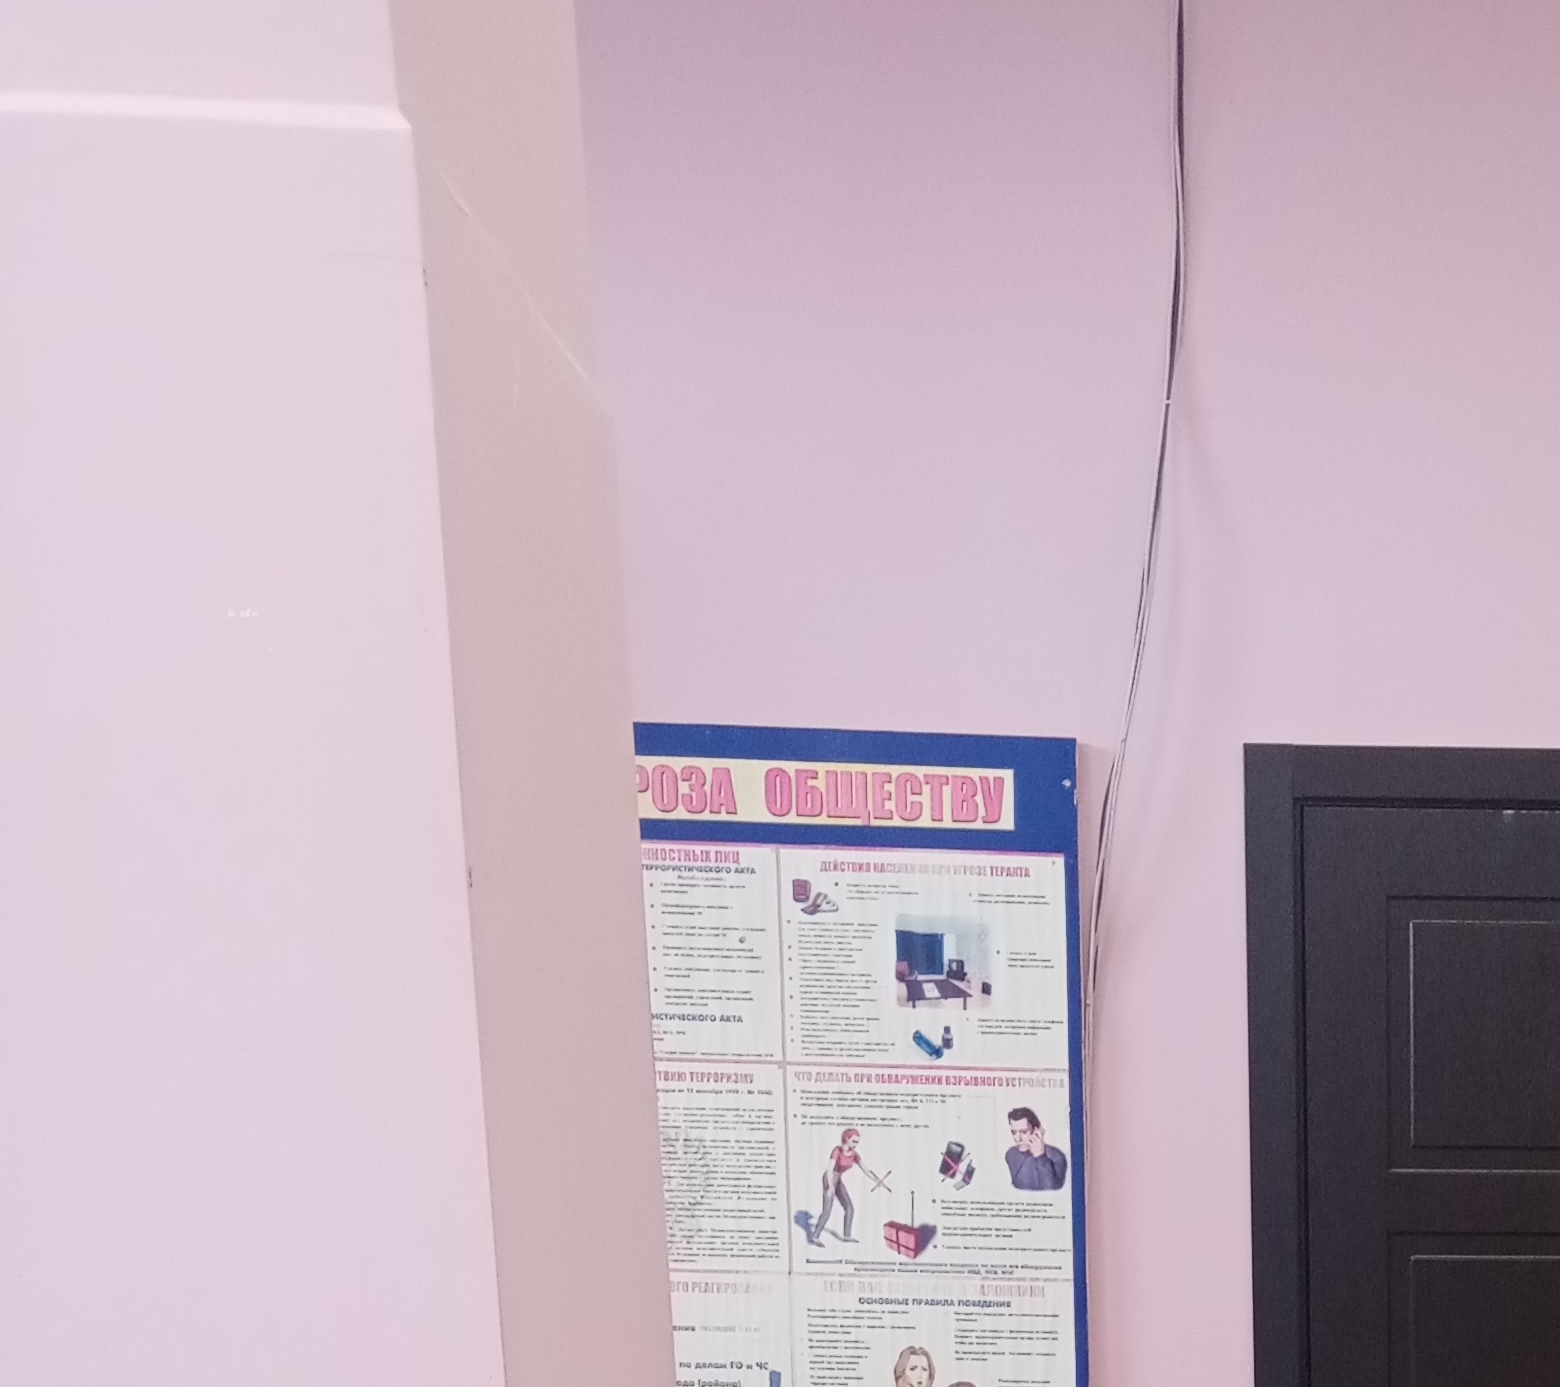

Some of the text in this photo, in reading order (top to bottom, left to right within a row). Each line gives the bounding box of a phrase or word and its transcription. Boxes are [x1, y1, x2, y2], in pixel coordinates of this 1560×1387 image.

[764, 767, 1005, 826] ОБЩЕСТВУ
[734, 866, 757, 875] АКТА
[819, 859, 871, 874] ДЕЙСТВИЯ
[989, 865, 1031, 878] ТЕРАКТА
[719, 1014, 744, 1024] АКТА
[689, 1071, 754, 1085] ТЕРРОРИЗМУ
[794, 1071, 813, 1083] ЧТО
[814, 1072, 852, 1084] ДЕЛАТЬ
[854, 1072, 873, 1084] ПРИ
[874, 1073, 943, 1086] ОБНАРУЖЕНИИ
[945, 1074, 1002, 1087] ВЗРЫВНОГО
[858, 1297, 1012, 1309] ОСНОВНЫЕ ПРАВИЛА ПОВЕДЕНИЯ
[730, 1361, 744, 1370] ГО
[755, 1361, 769, 1371] ЧС
